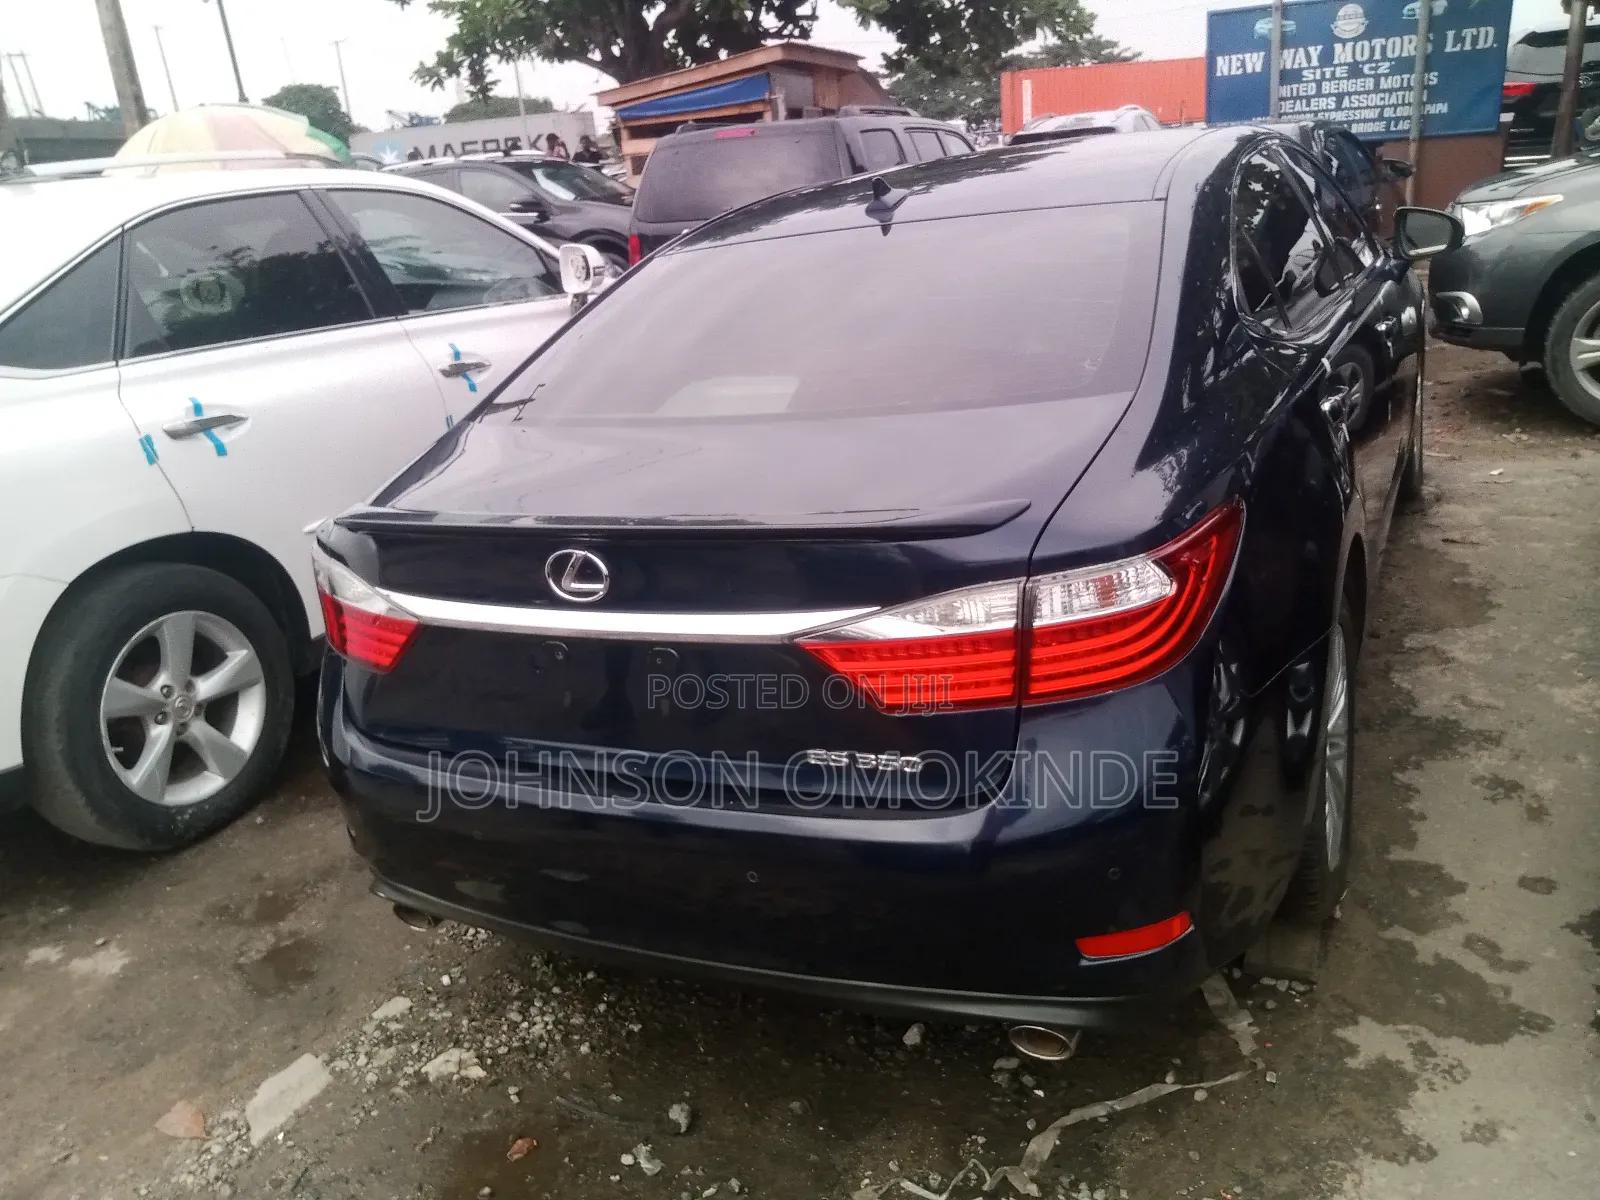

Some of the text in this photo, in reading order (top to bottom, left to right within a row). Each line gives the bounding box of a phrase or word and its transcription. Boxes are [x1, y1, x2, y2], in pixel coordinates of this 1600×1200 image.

[1215, 51, 1265, 77] NEW
[1280, 44, 1324, 70] WAY
[1444, 25, 1498, 53] LTD.
[1301, 65, 1349, 81] SITE
[1279, 82, 1317, 98] NITED
[1321, 77, 1375, 95] BERGER
[807, 748, 921, 773] ES 350
